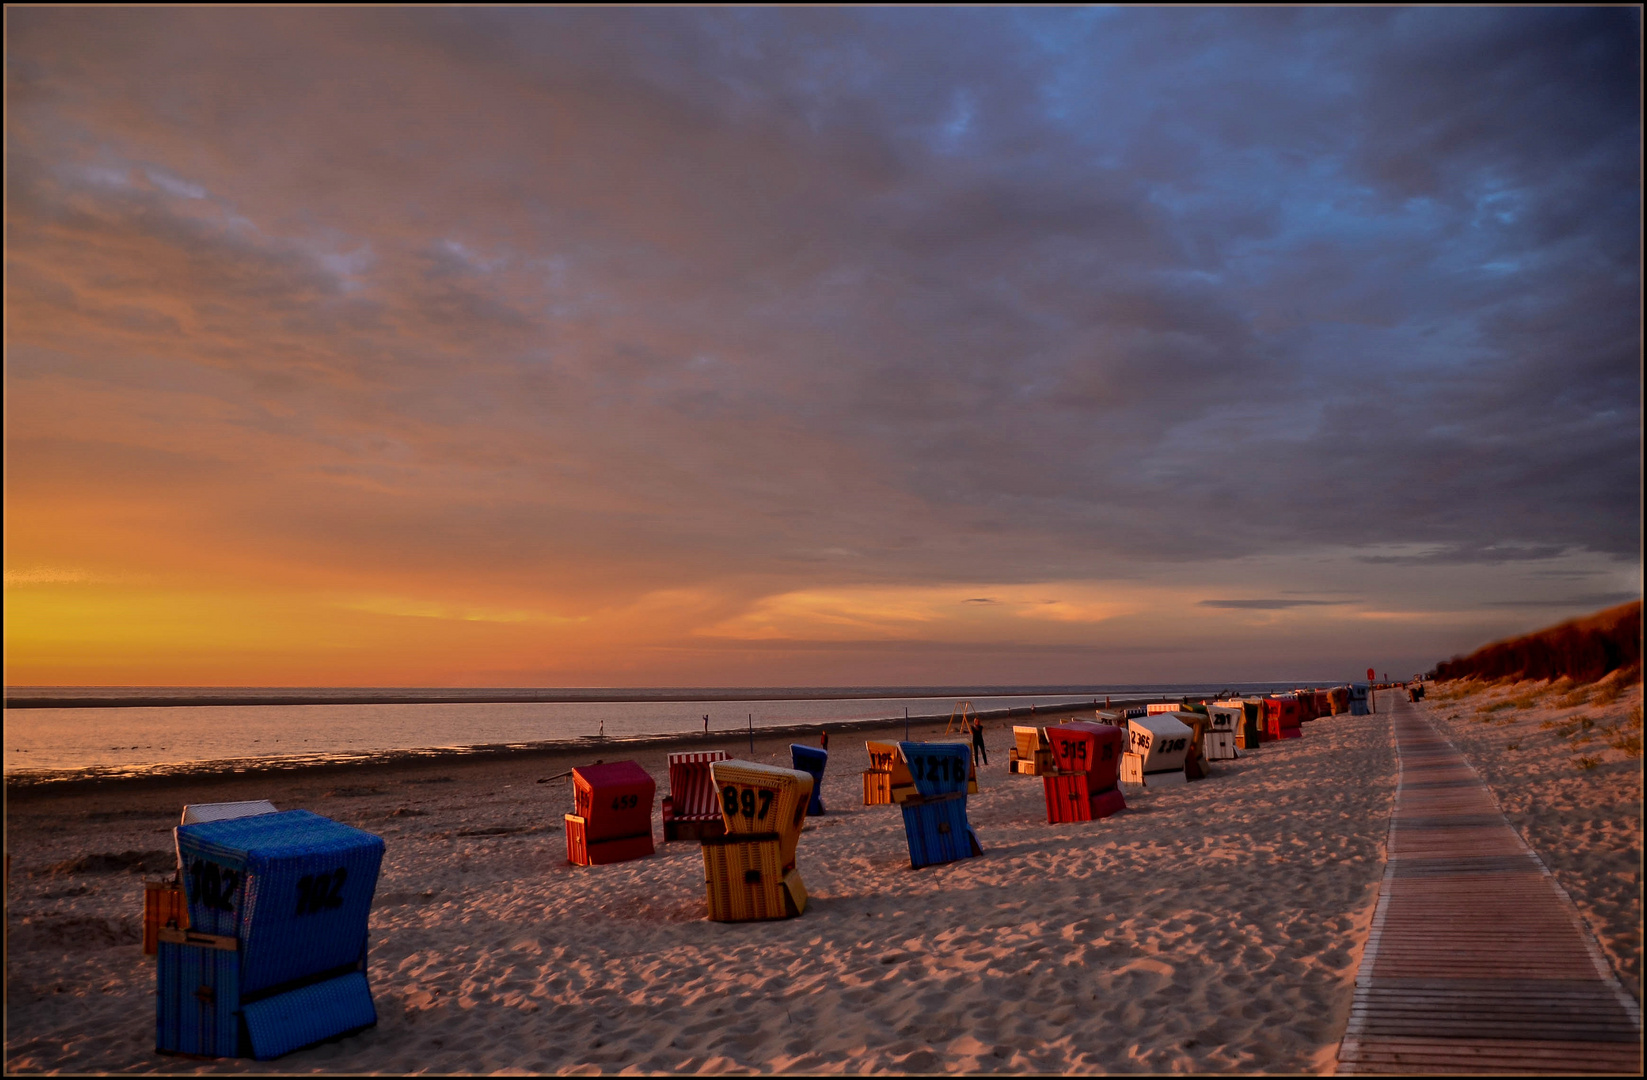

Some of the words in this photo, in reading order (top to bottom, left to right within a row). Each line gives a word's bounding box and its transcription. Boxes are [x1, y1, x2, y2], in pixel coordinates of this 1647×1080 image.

[1060, 741, 1087, 759] 315
[1131, 731, 1150, 749] 2365
[1158, 738, 1186, 753] 2365
[914, 755, 965, 782] 1216
[723, 786, 773, 819] 897
[191, 860, 239, 911] 102
[297, 868, 347, 916] 102
